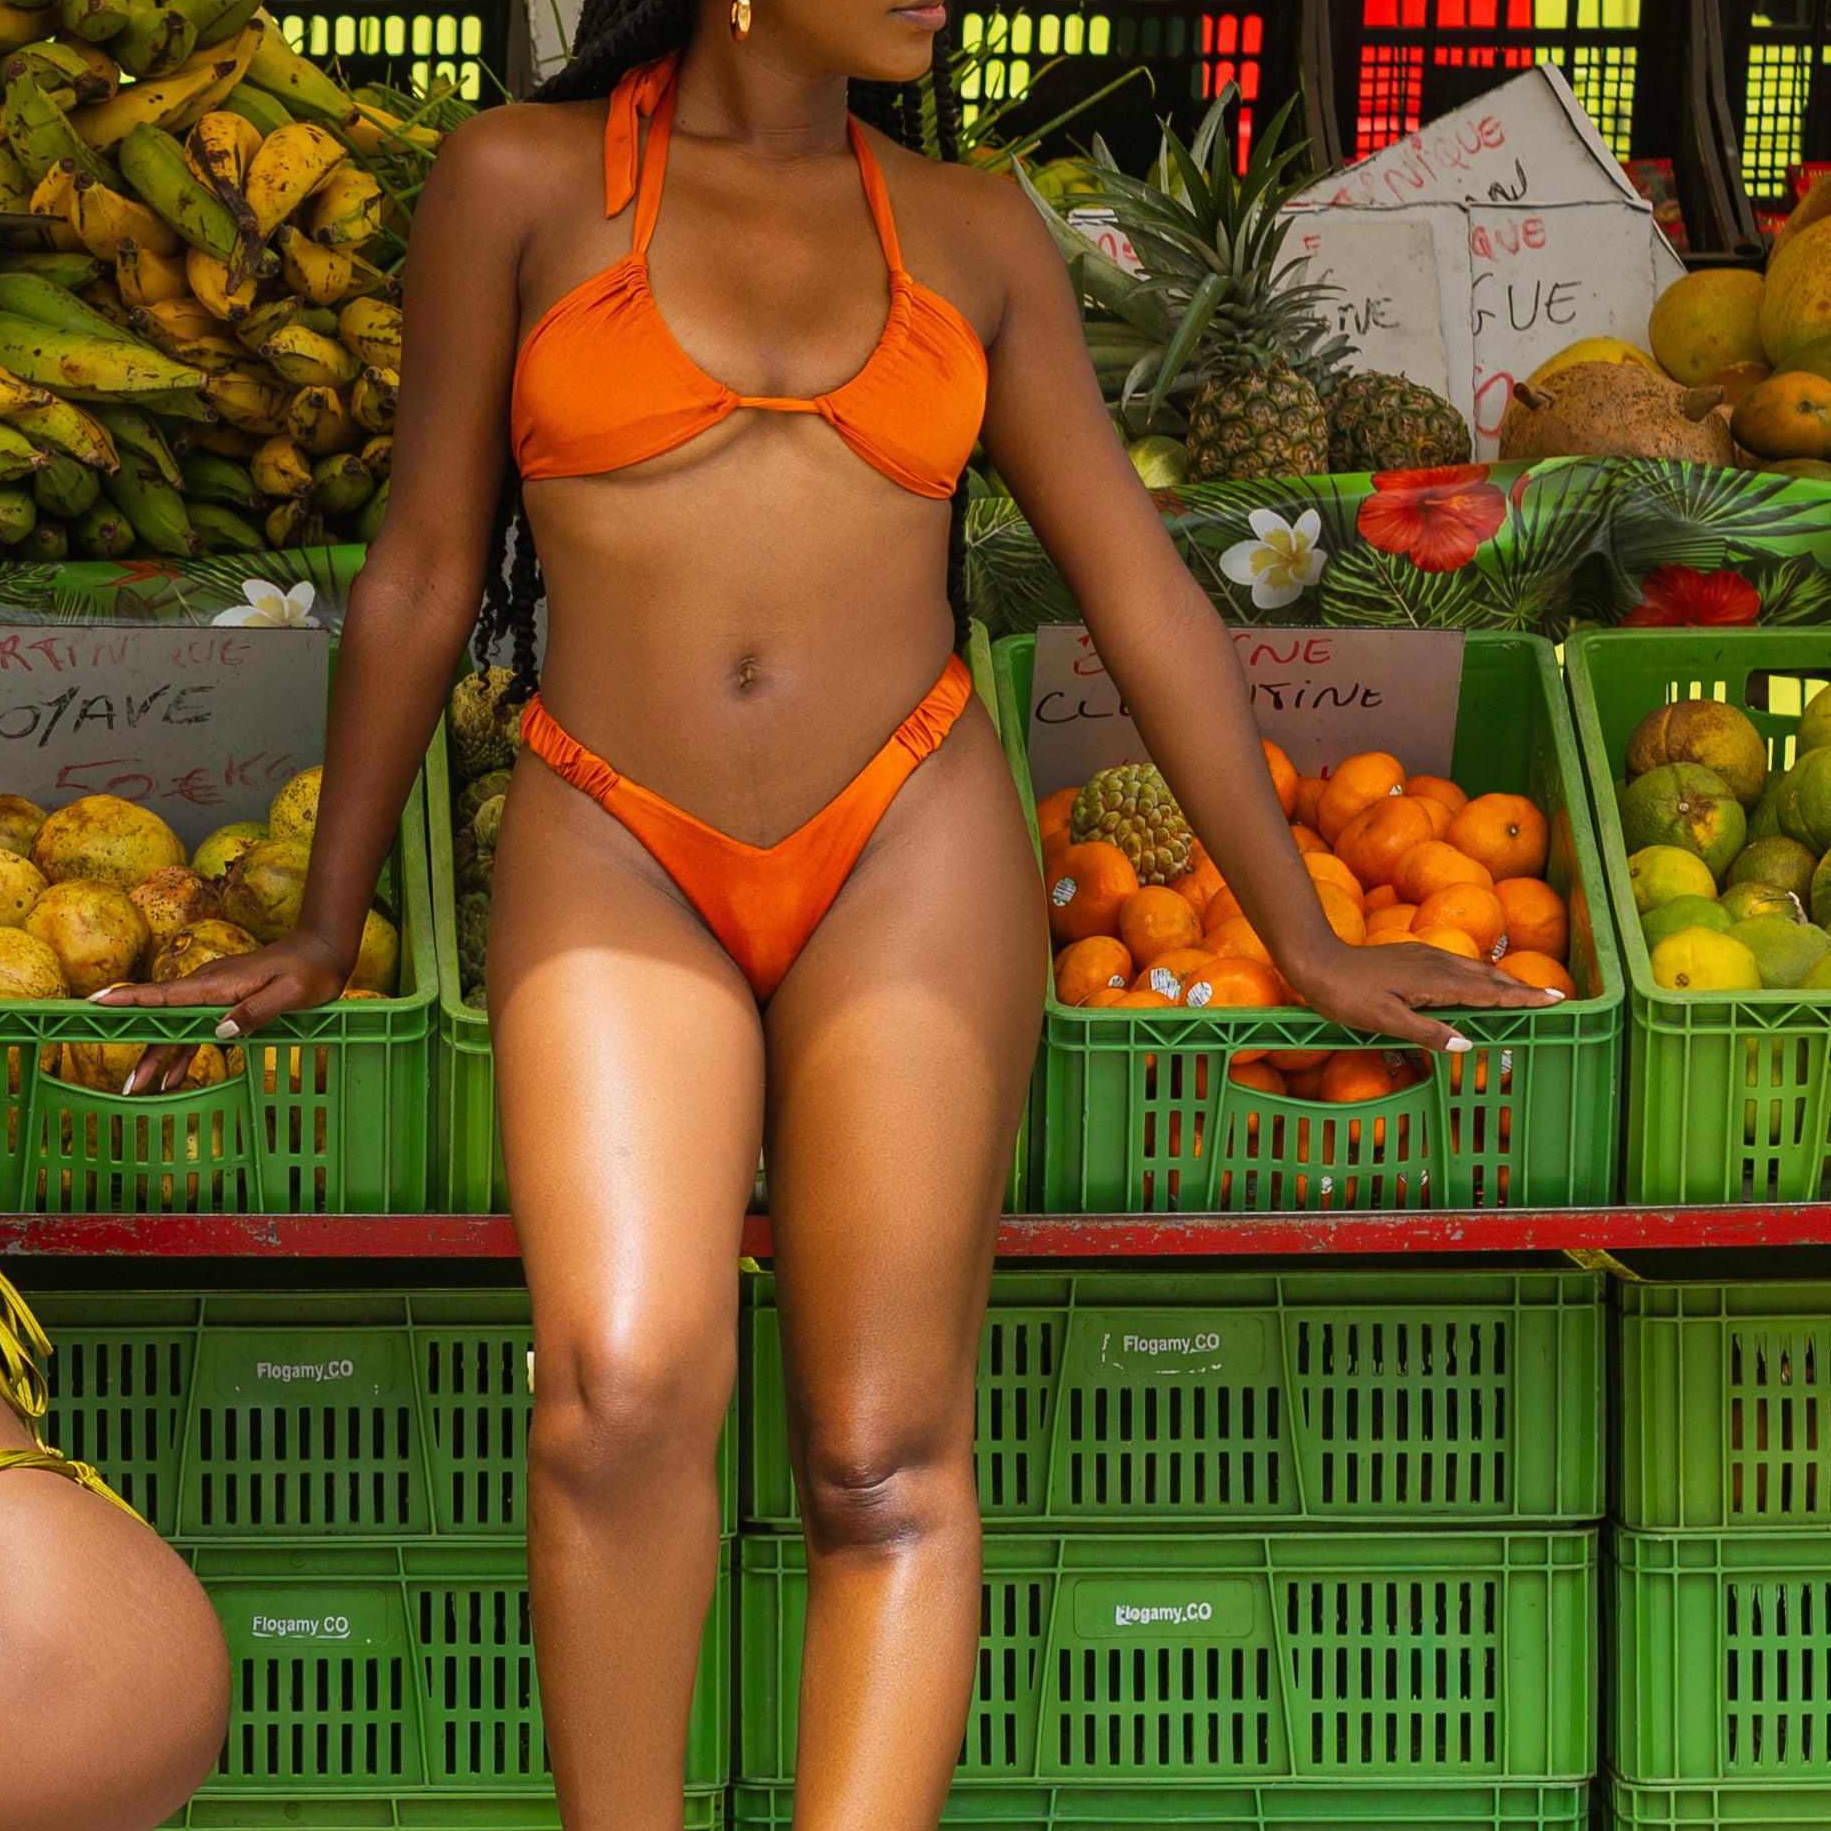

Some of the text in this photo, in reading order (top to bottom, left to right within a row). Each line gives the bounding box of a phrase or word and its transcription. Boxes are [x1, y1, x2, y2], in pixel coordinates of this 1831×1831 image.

[1123, 1332, 1220, 1356] Flogamy CO
[256, 1359, 354, 1382] Flogamy CO
[1186, 1601, 1212, 1620] CO
[252, 1615, 349, 1636] Flogamy CO
